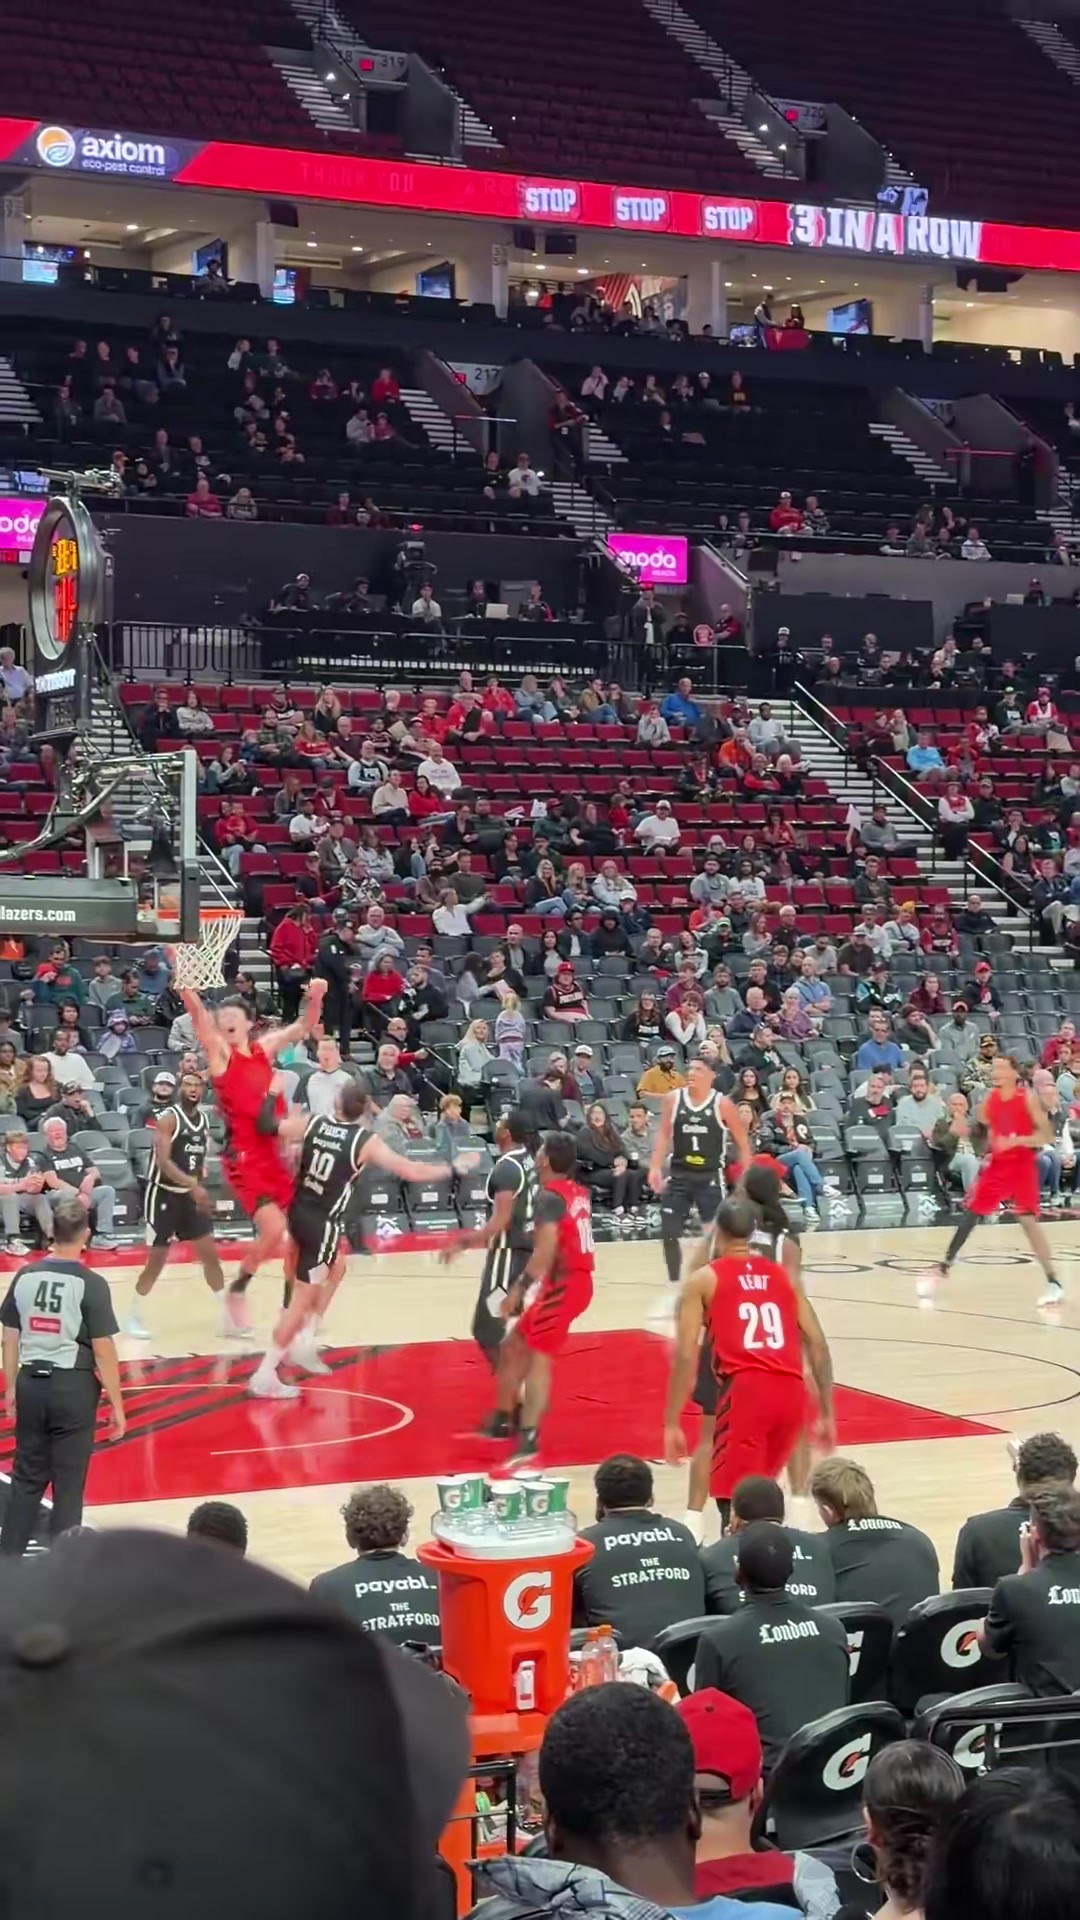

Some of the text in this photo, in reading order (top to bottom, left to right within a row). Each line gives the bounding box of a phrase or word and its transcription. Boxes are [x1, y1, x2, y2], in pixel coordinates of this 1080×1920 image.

[81, 134, 165, 165] axiom
[82, 159, 166, 176] eco-pest control
[525, 188, 577, 213] STOP
[616, 197, 666, 221] STOP
[704, 206, 753, 231] STOP
[795, 204, 981, 260] 3 IN A ROW
[475, 367, 500, 382] 217
[619, 548, 676, 568] moda
[0, 905, 76, 921] lazers.com
[308, 1149, 336, 1182] 10
[34, 1280, 65, 1313] 45
[738, 1302, 785, 1349] 29
[604, 1527, 684, 1551] payabl.
[640, 1557, 660, 1568] THE
[355, 1575, 437, 1598] payabl.
[611, 1567, 690, 1588] STRATFORD
[389, 1602, 410, 1612] THE
[503, 1570, 551, 1630] G
[1048, 1585, 1080, 1605] Lon
[361, 1612, 440, 1632] STRATFORD
[759, 1619, 820, 1644] London
[823, 1732, 872, 1790] G
